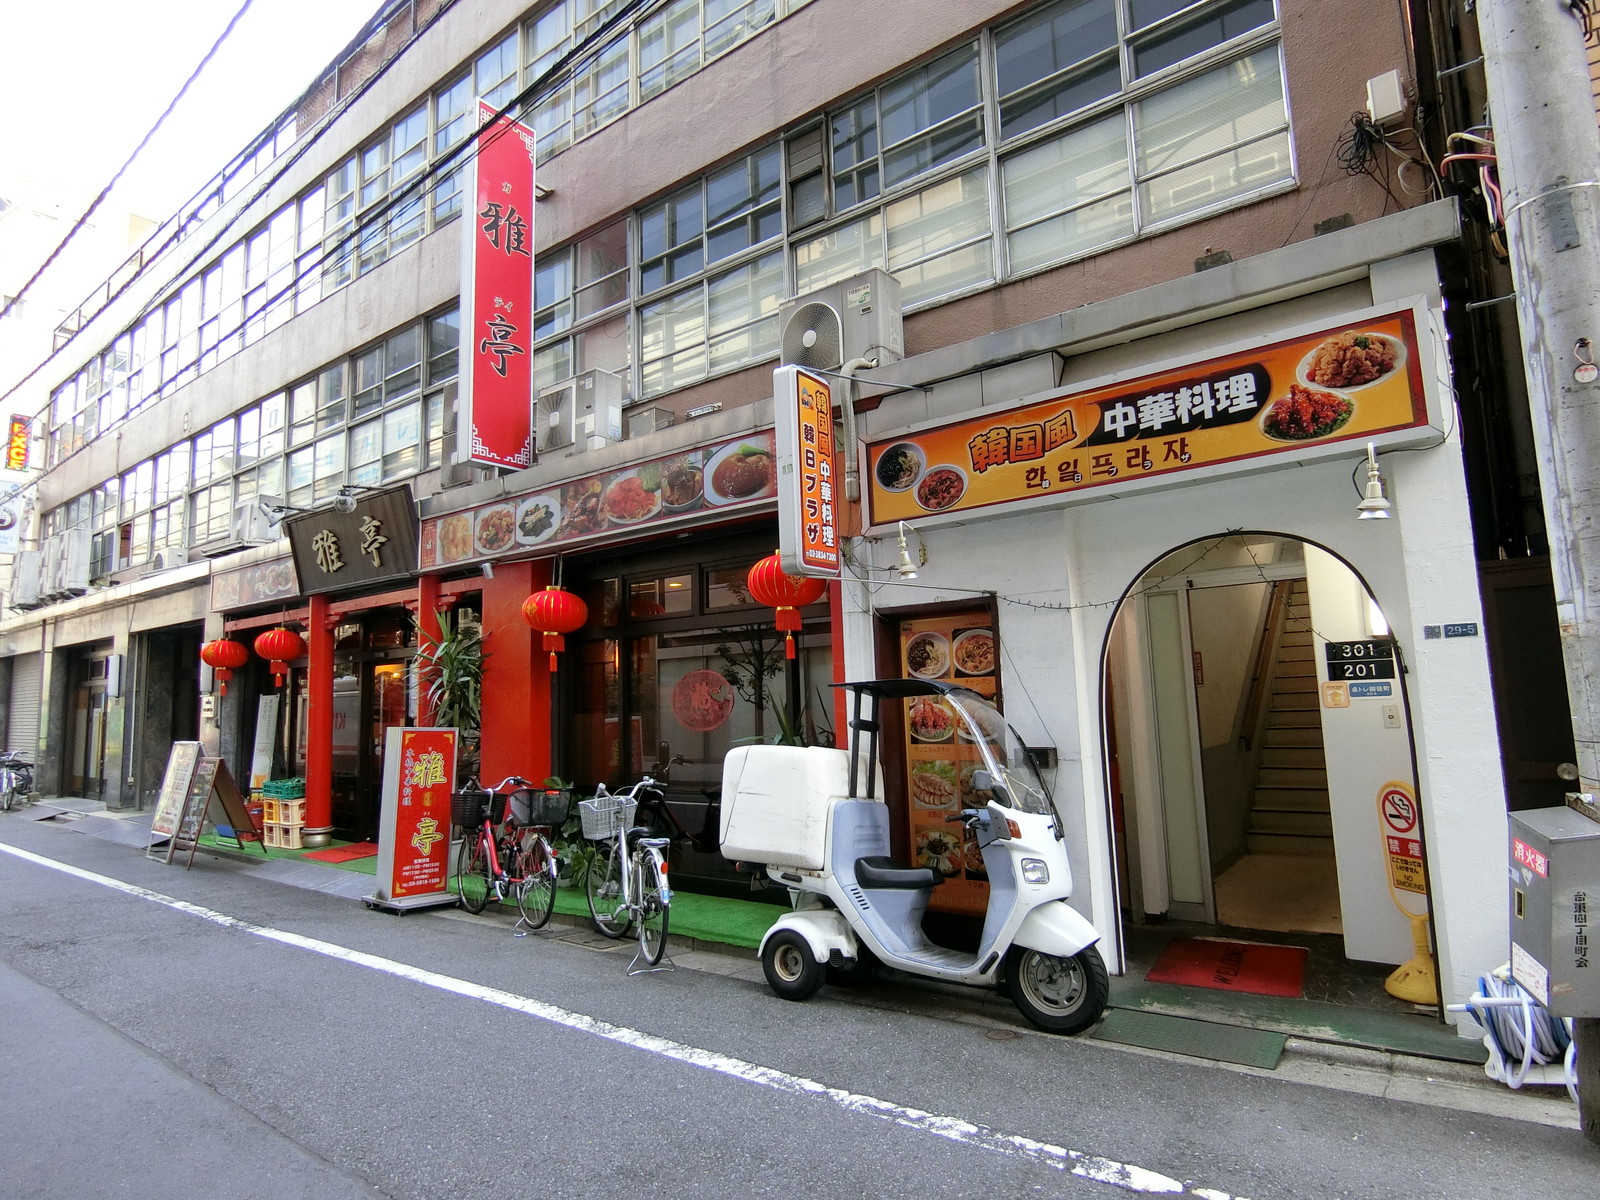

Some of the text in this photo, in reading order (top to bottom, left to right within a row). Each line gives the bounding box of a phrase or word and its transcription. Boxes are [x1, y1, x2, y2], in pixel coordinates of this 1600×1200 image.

[968, 372, 1258, 473] 韓国風 中華料理
[803, 423, 820, 544] 韓日プラザ
[1447, 625, 1475, 635] 29-5
[1342, 643, 1374, 658] 301
[1344, 663, 1376, 677] 201
[1388, 838, 1422, 857] 禁煙
[1514, 840, 1546, 875] 消火器
[1395, 878, 1425, 892] SMOKING
[1403, 874, 1414, 882] NO
